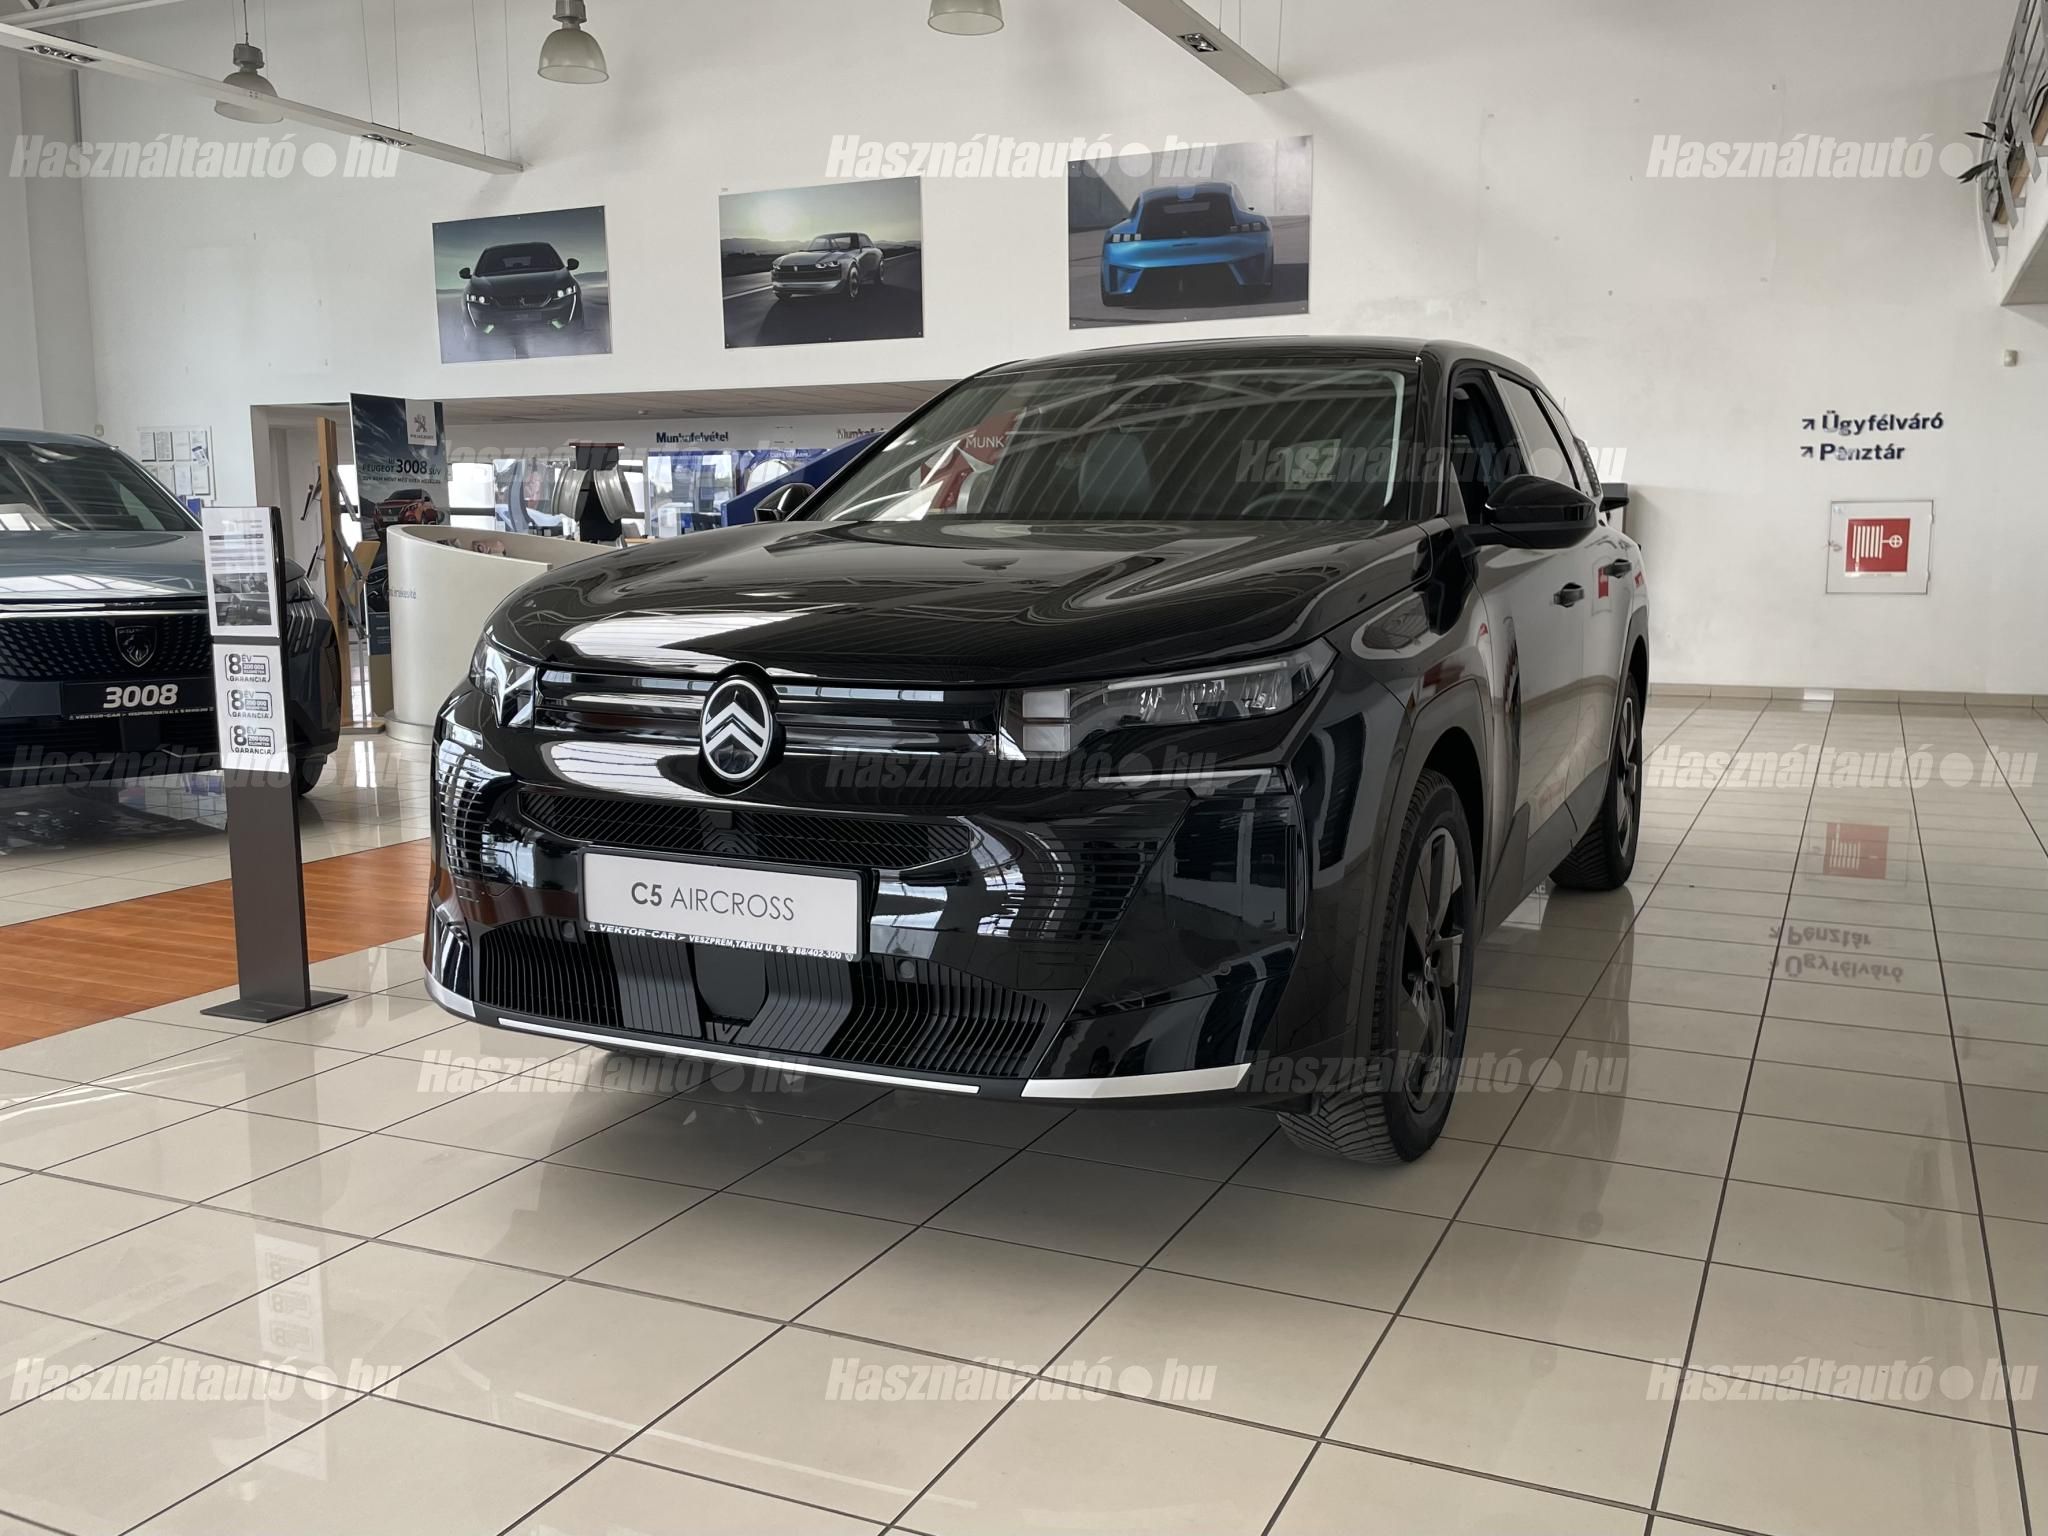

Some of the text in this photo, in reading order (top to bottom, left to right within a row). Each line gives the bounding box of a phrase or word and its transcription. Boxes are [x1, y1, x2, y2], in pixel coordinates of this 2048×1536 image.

[1822, 410, 1944, 436] Ügyfélváró
[396, 458, 428, 475] 3008
[229, 653, 241, 675] 8
[103, 684, 178, 708] 3008
[231, 689, 244, 711] 8
[233, 725, 247, 746] 8
[631, 882, 794, 921] C5 AIRCROSS
[599, 924, 677, 940] VEKTOR-CAR
